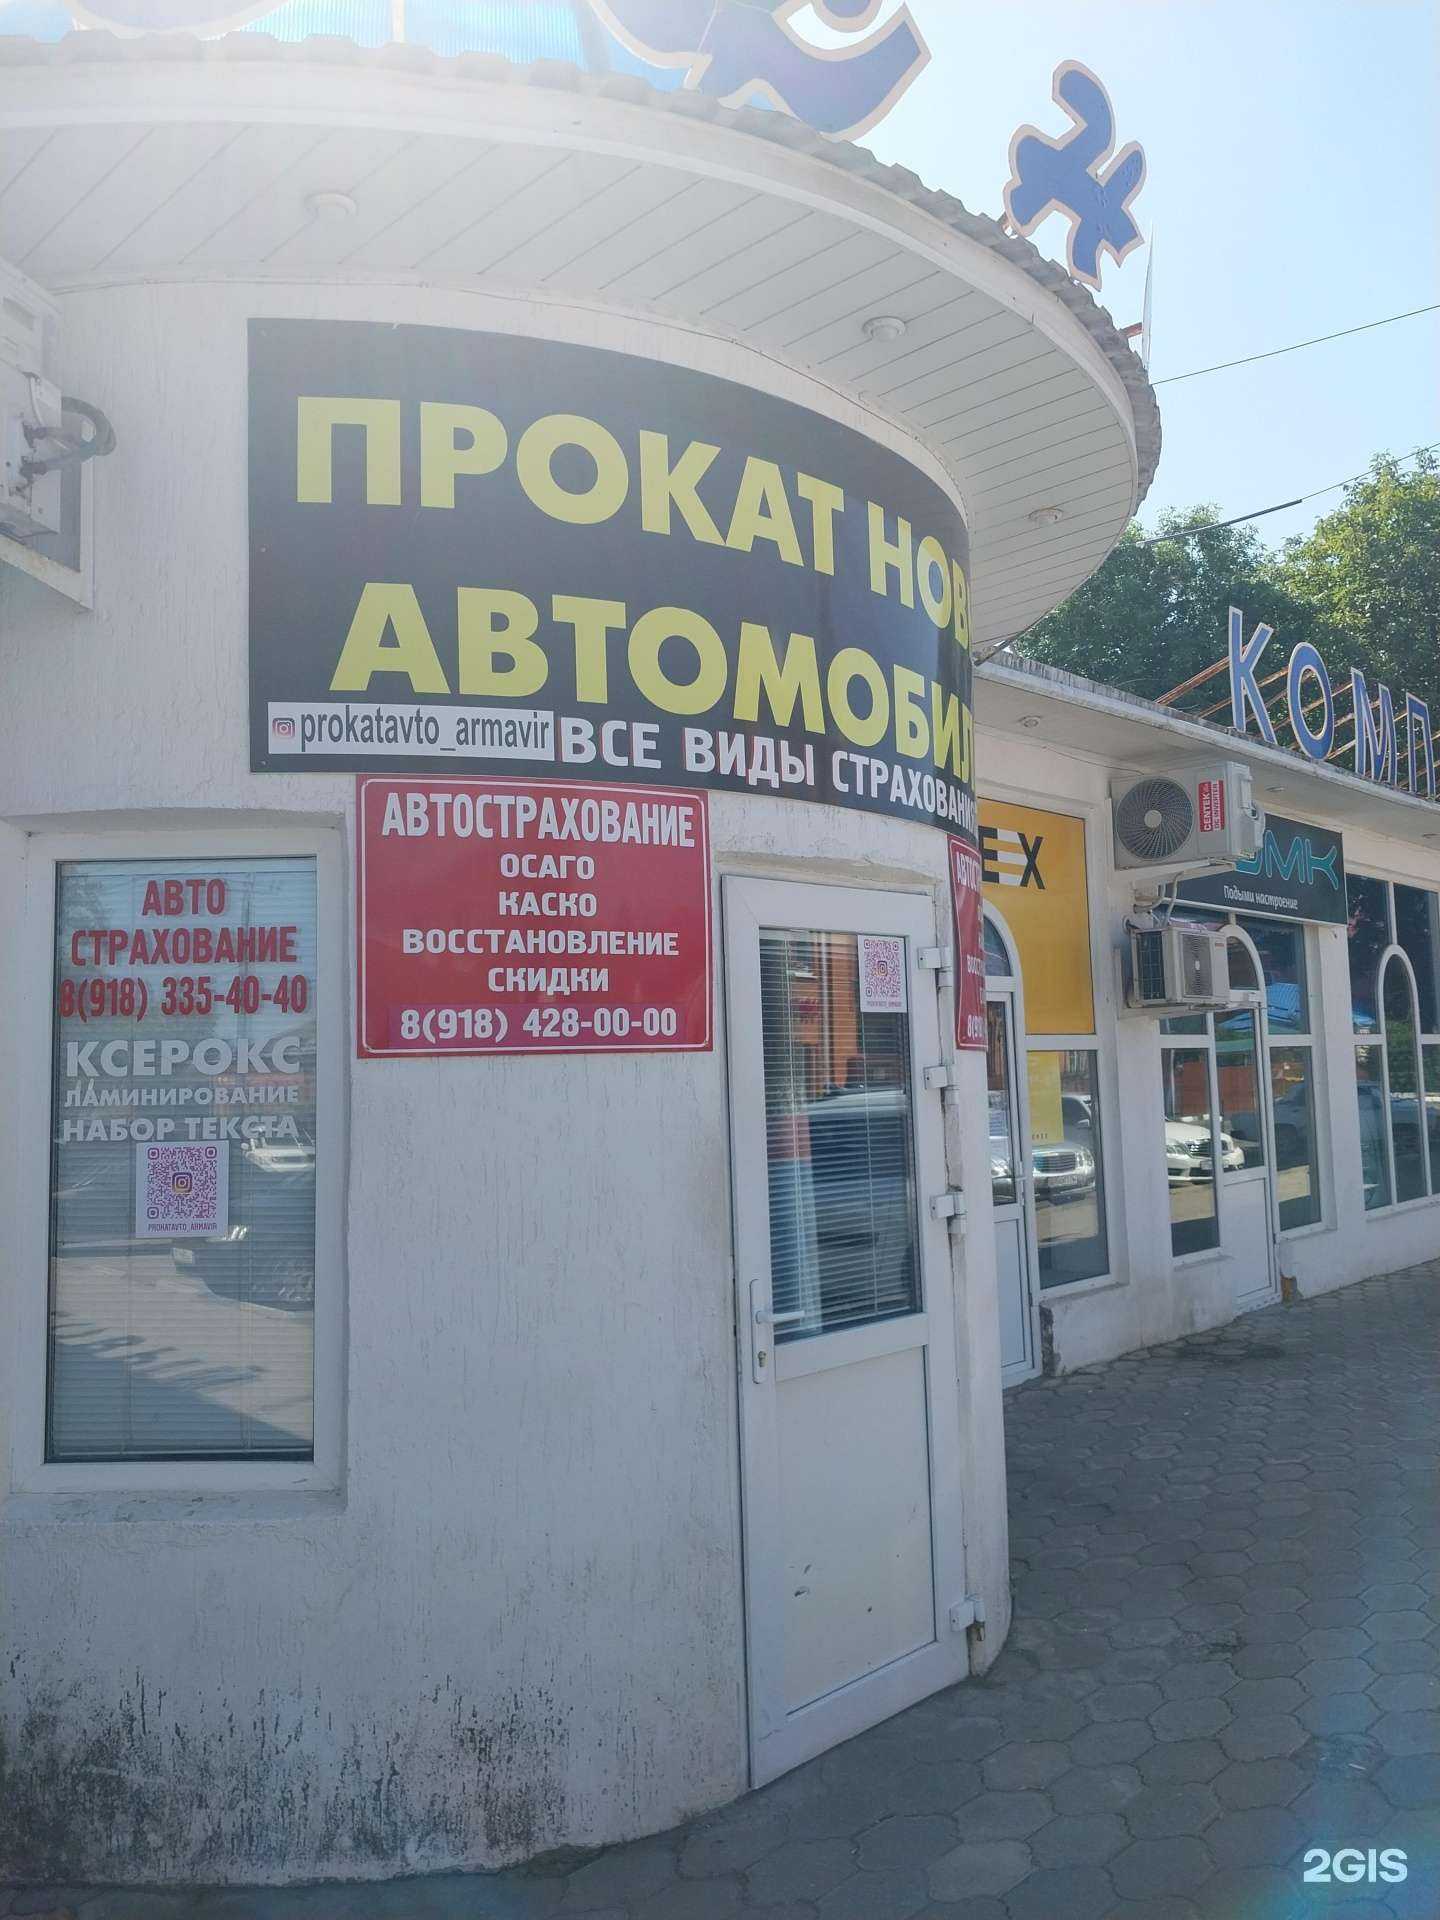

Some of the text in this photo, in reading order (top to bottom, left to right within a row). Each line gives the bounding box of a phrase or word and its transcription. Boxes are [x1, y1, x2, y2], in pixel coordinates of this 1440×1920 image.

[297, 396, 973, 650] ПРОКАТ НОВ
[301, 704, 550, 753] prokatavto_armavir
[561, 717, 662, 771] ВСЕ
[684, 727, 815, 787] ВИДЫ
[382, 792, 696, 848] АВТОСТРАХОВАНИЕ
[1203, 792, 1211, 831] CENTEK
[500, 854, 595, 880] ОСАГО
[142, 878, 226, 916] АВТО
[499, 892, 597, 917] КАСКО
[1255, 893, 1298, 910] настроение
[71, 926, 297, 966] СТРАХОВАНИЕ
[402, 929, 680, 956] ВОССТАНОВЛЕНИЕ
[59, 975, 307, 1022] 8(918) 335-40-40
[488, 967, 609, 996] СКИДКИ
[401, 1007, 677, 1044] 8(918) 428-00-00
[66, 1037, 300, 1077] КСЕРОКС
[64, 1082, 299, 1108] ЛАМИНИРОВАНИЕ
[63, 1115, 299, 1141] НАБОР ТЕКСТА
